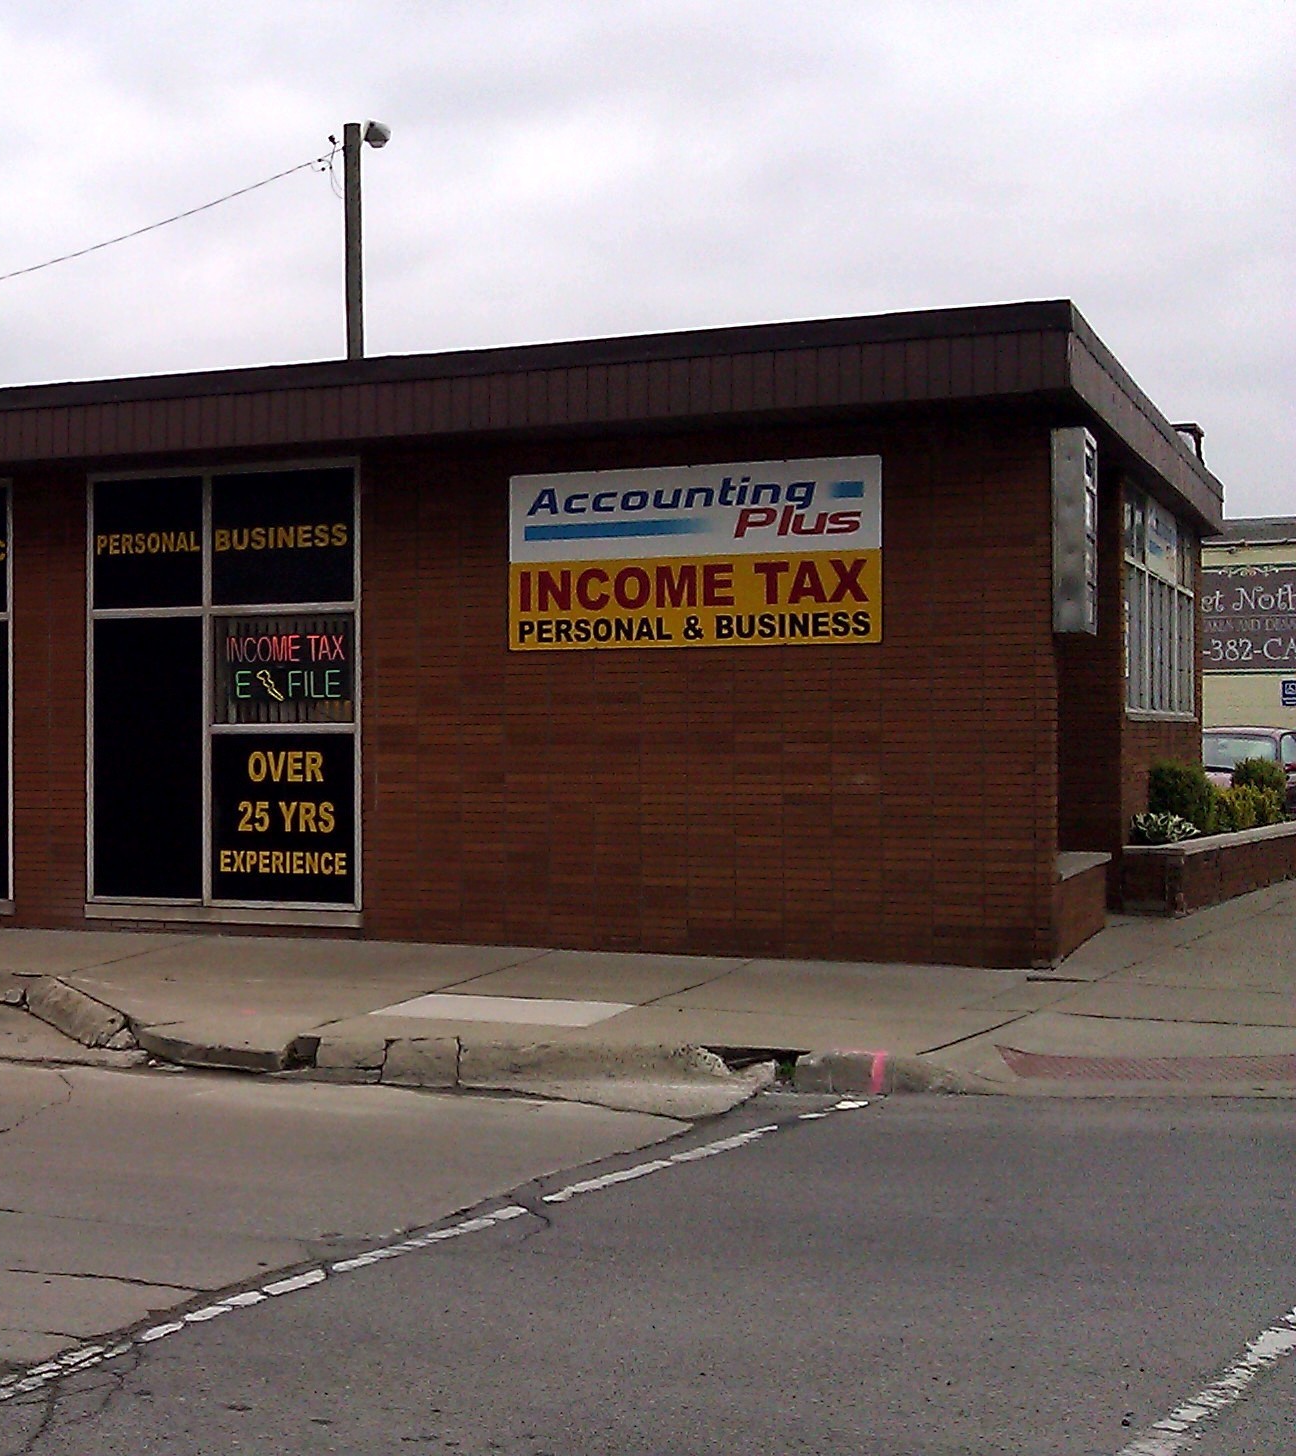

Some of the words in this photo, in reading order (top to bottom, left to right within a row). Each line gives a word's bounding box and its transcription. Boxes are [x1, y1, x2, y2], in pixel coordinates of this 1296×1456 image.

[527, 477, 817, 516] Accounting
[733, 505, 862, 539] Plus
[97, 531, 200, 555] PERSONAL
[215, 523, 347, 552] BUSINESS
[520, 563, 734, 612] INCOME
[754, 558, 869, 605] TAX
[518, 616, 672, 643] PERSONAL
[683, 615, 704, 641] &
[715, 611, 871, 640] BUSINESS
[226, 635, 301, 663] INCOME
[306, 635, 346, 662] TAX
[235, 670, 252, 699] E
[288, 669, 341, 698] FILE
[248, 751, 324, 782] OVER
[238, 801, 270, 832] 25
[279, 801, 335, 833] YRS
[220, 850, 347, 875] EXPERIENCE
